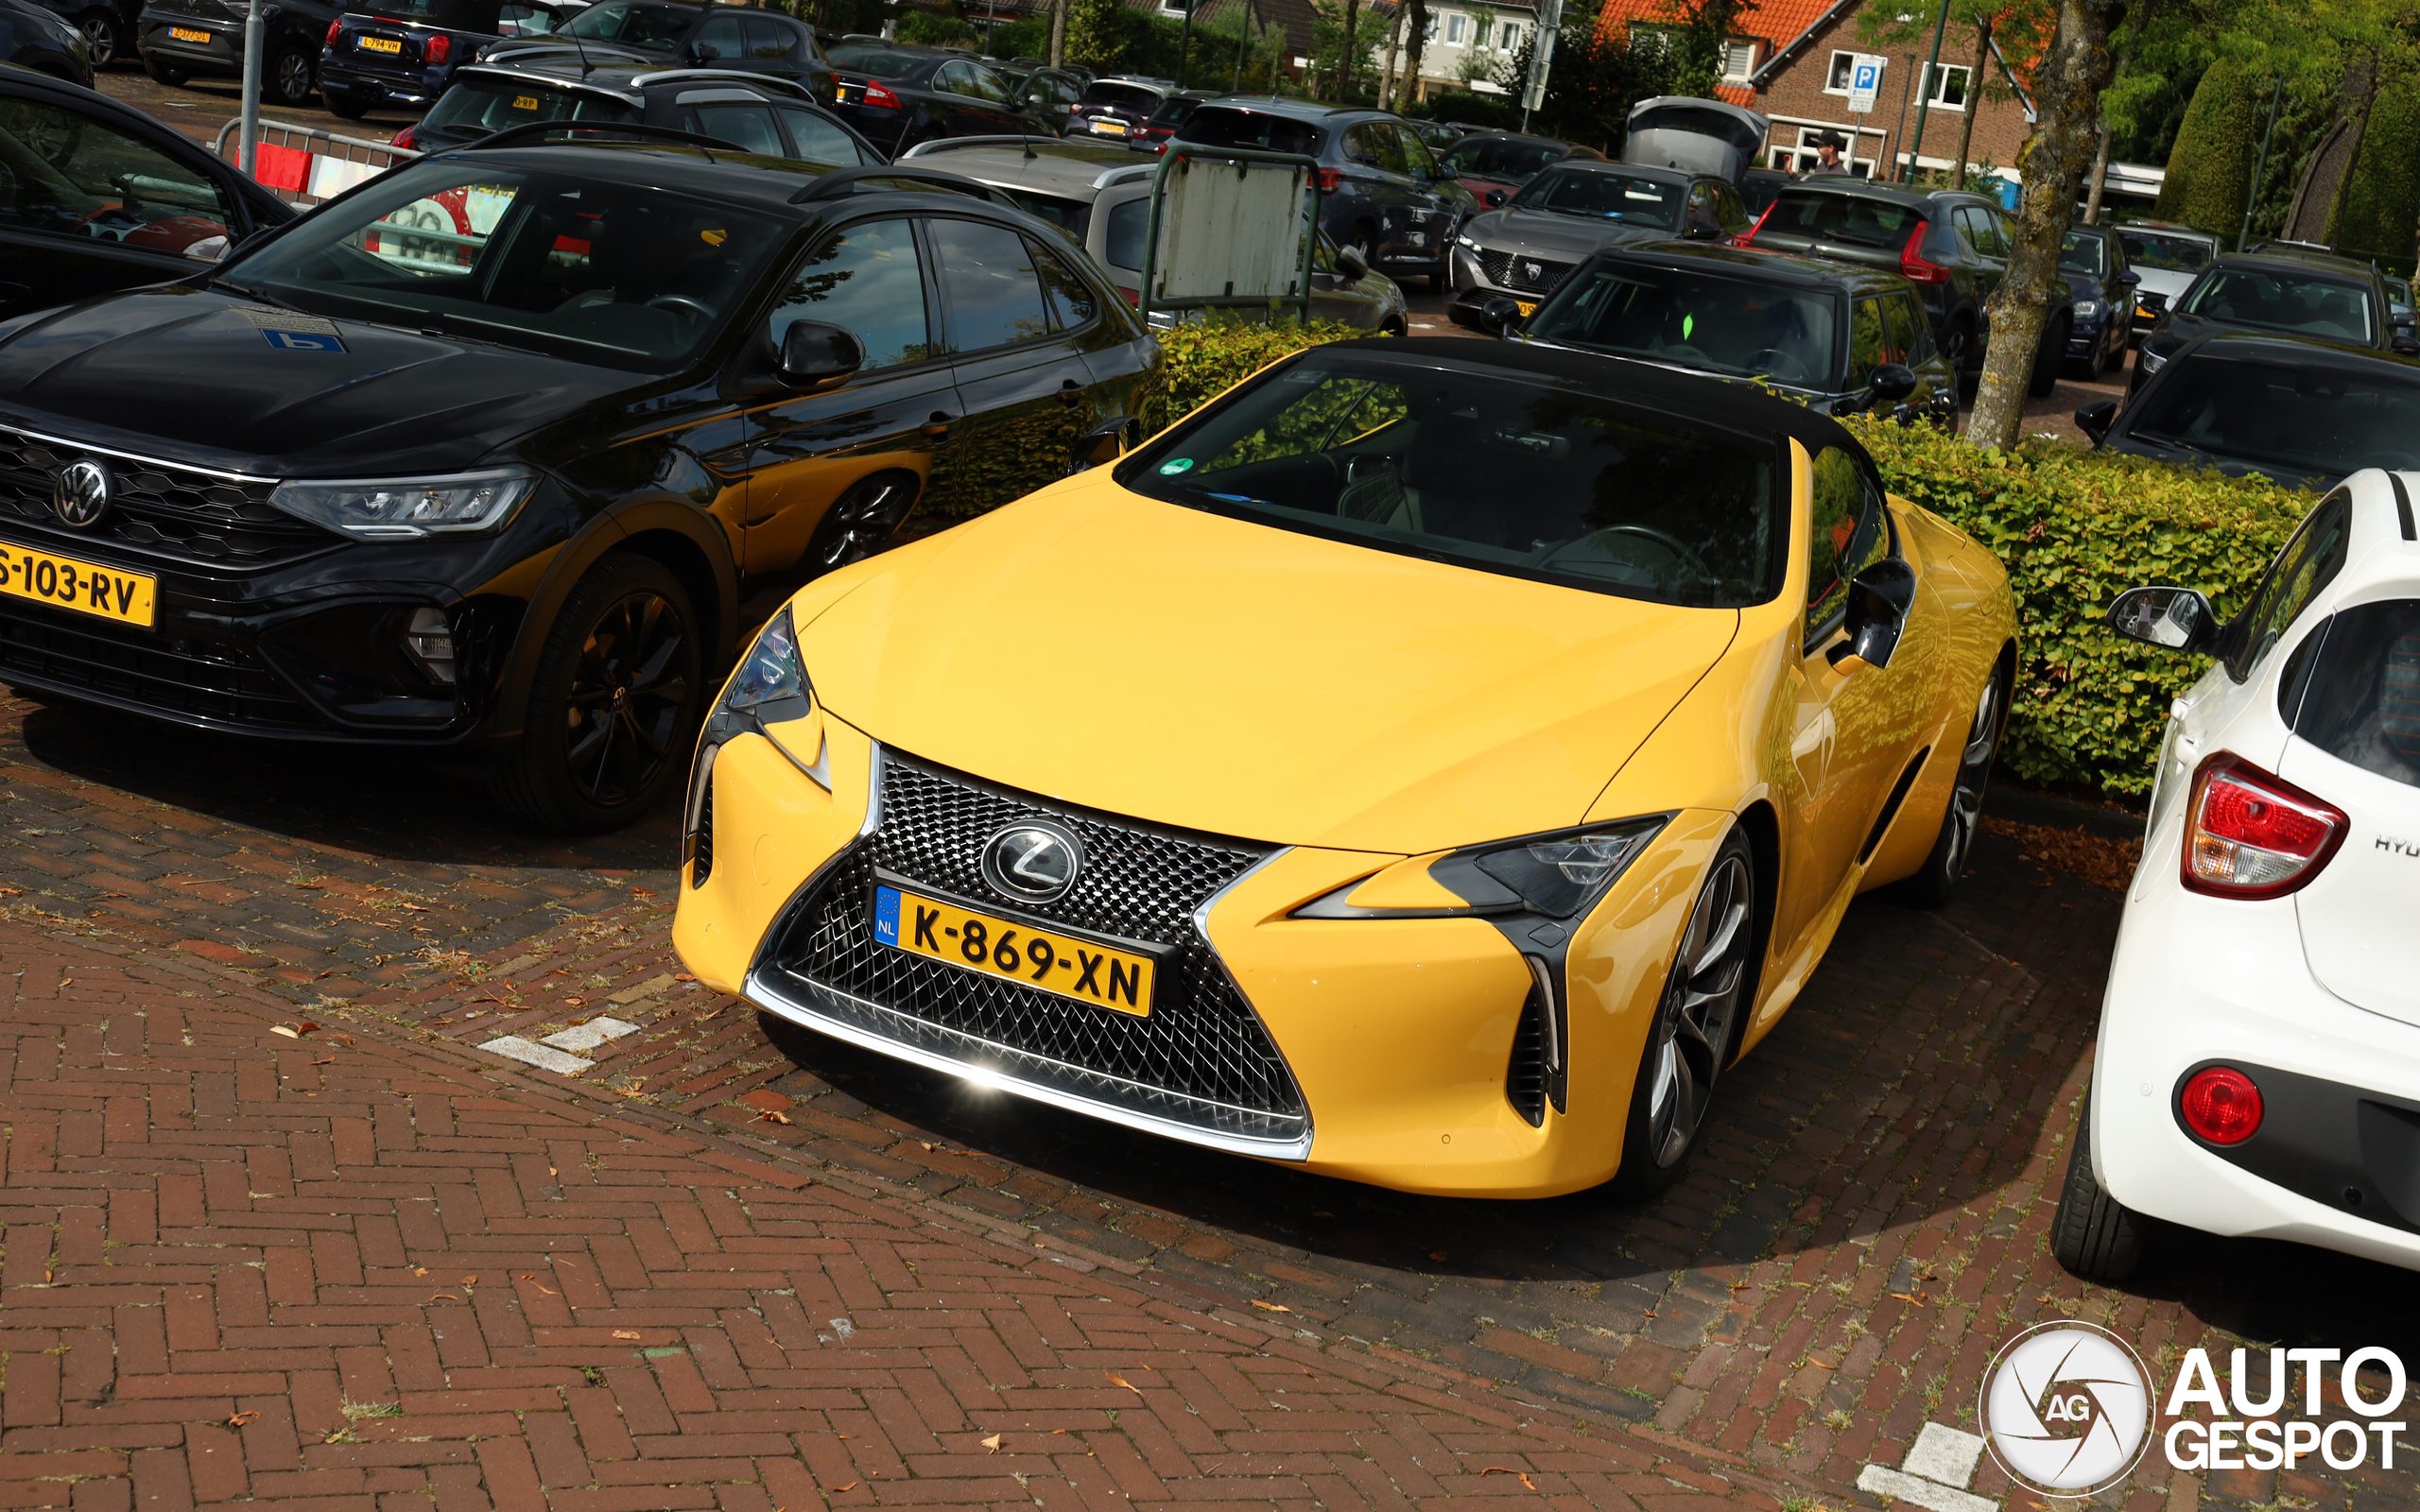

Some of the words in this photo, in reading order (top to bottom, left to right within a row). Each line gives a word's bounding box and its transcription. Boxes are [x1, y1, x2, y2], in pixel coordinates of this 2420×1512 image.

[364, 38, 398, 51] L-794-VH
[1858, 67, 1873, 87] P
[878, 919, 895, 936] NL
[915, 904, 1140, 1006] K-869-XN
